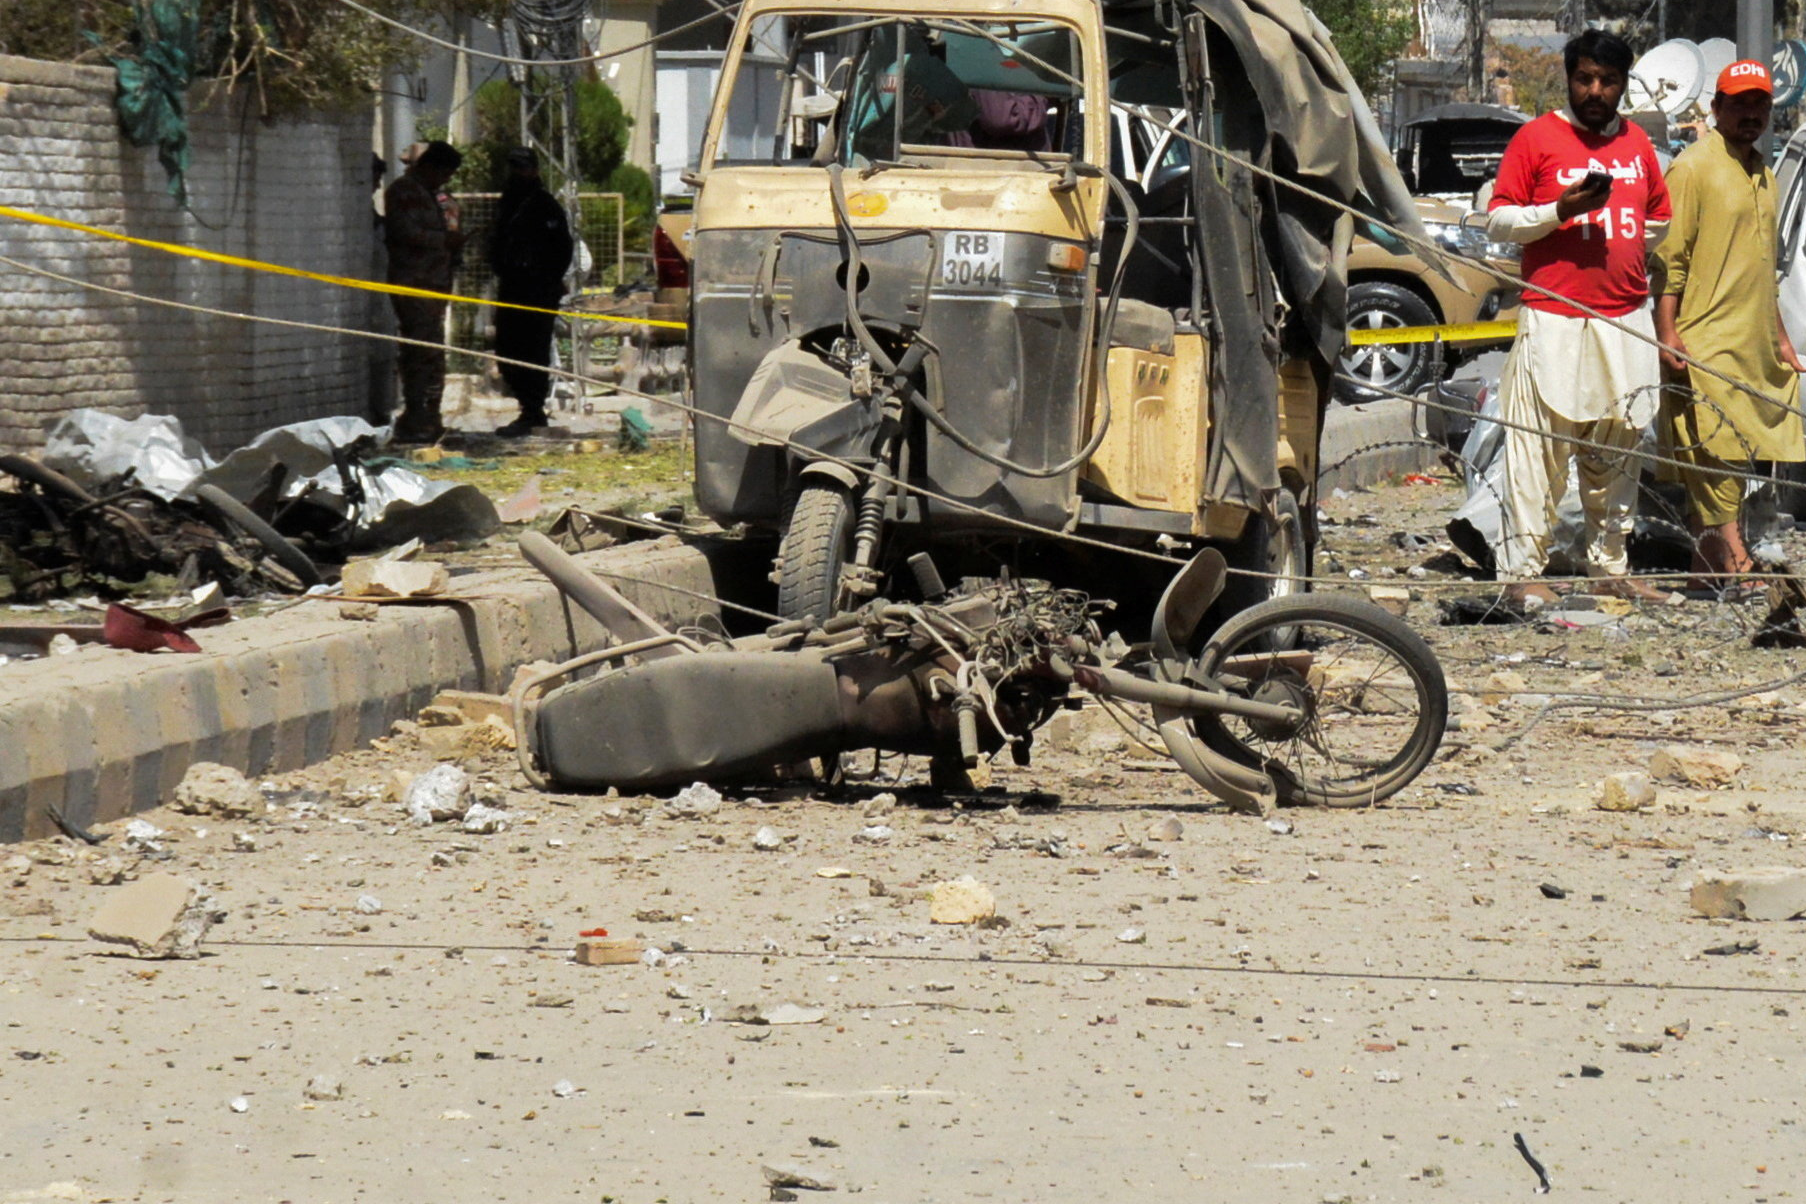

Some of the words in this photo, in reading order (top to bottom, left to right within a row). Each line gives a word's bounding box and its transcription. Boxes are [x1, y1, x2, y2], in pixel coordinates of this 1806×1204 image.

[1729, 62, 1766, 78] EDHI
[1573, 207, 1637, 240] 115
[955, 234, 989, 255] RB
[944, 259, 1002, 287] 3044
